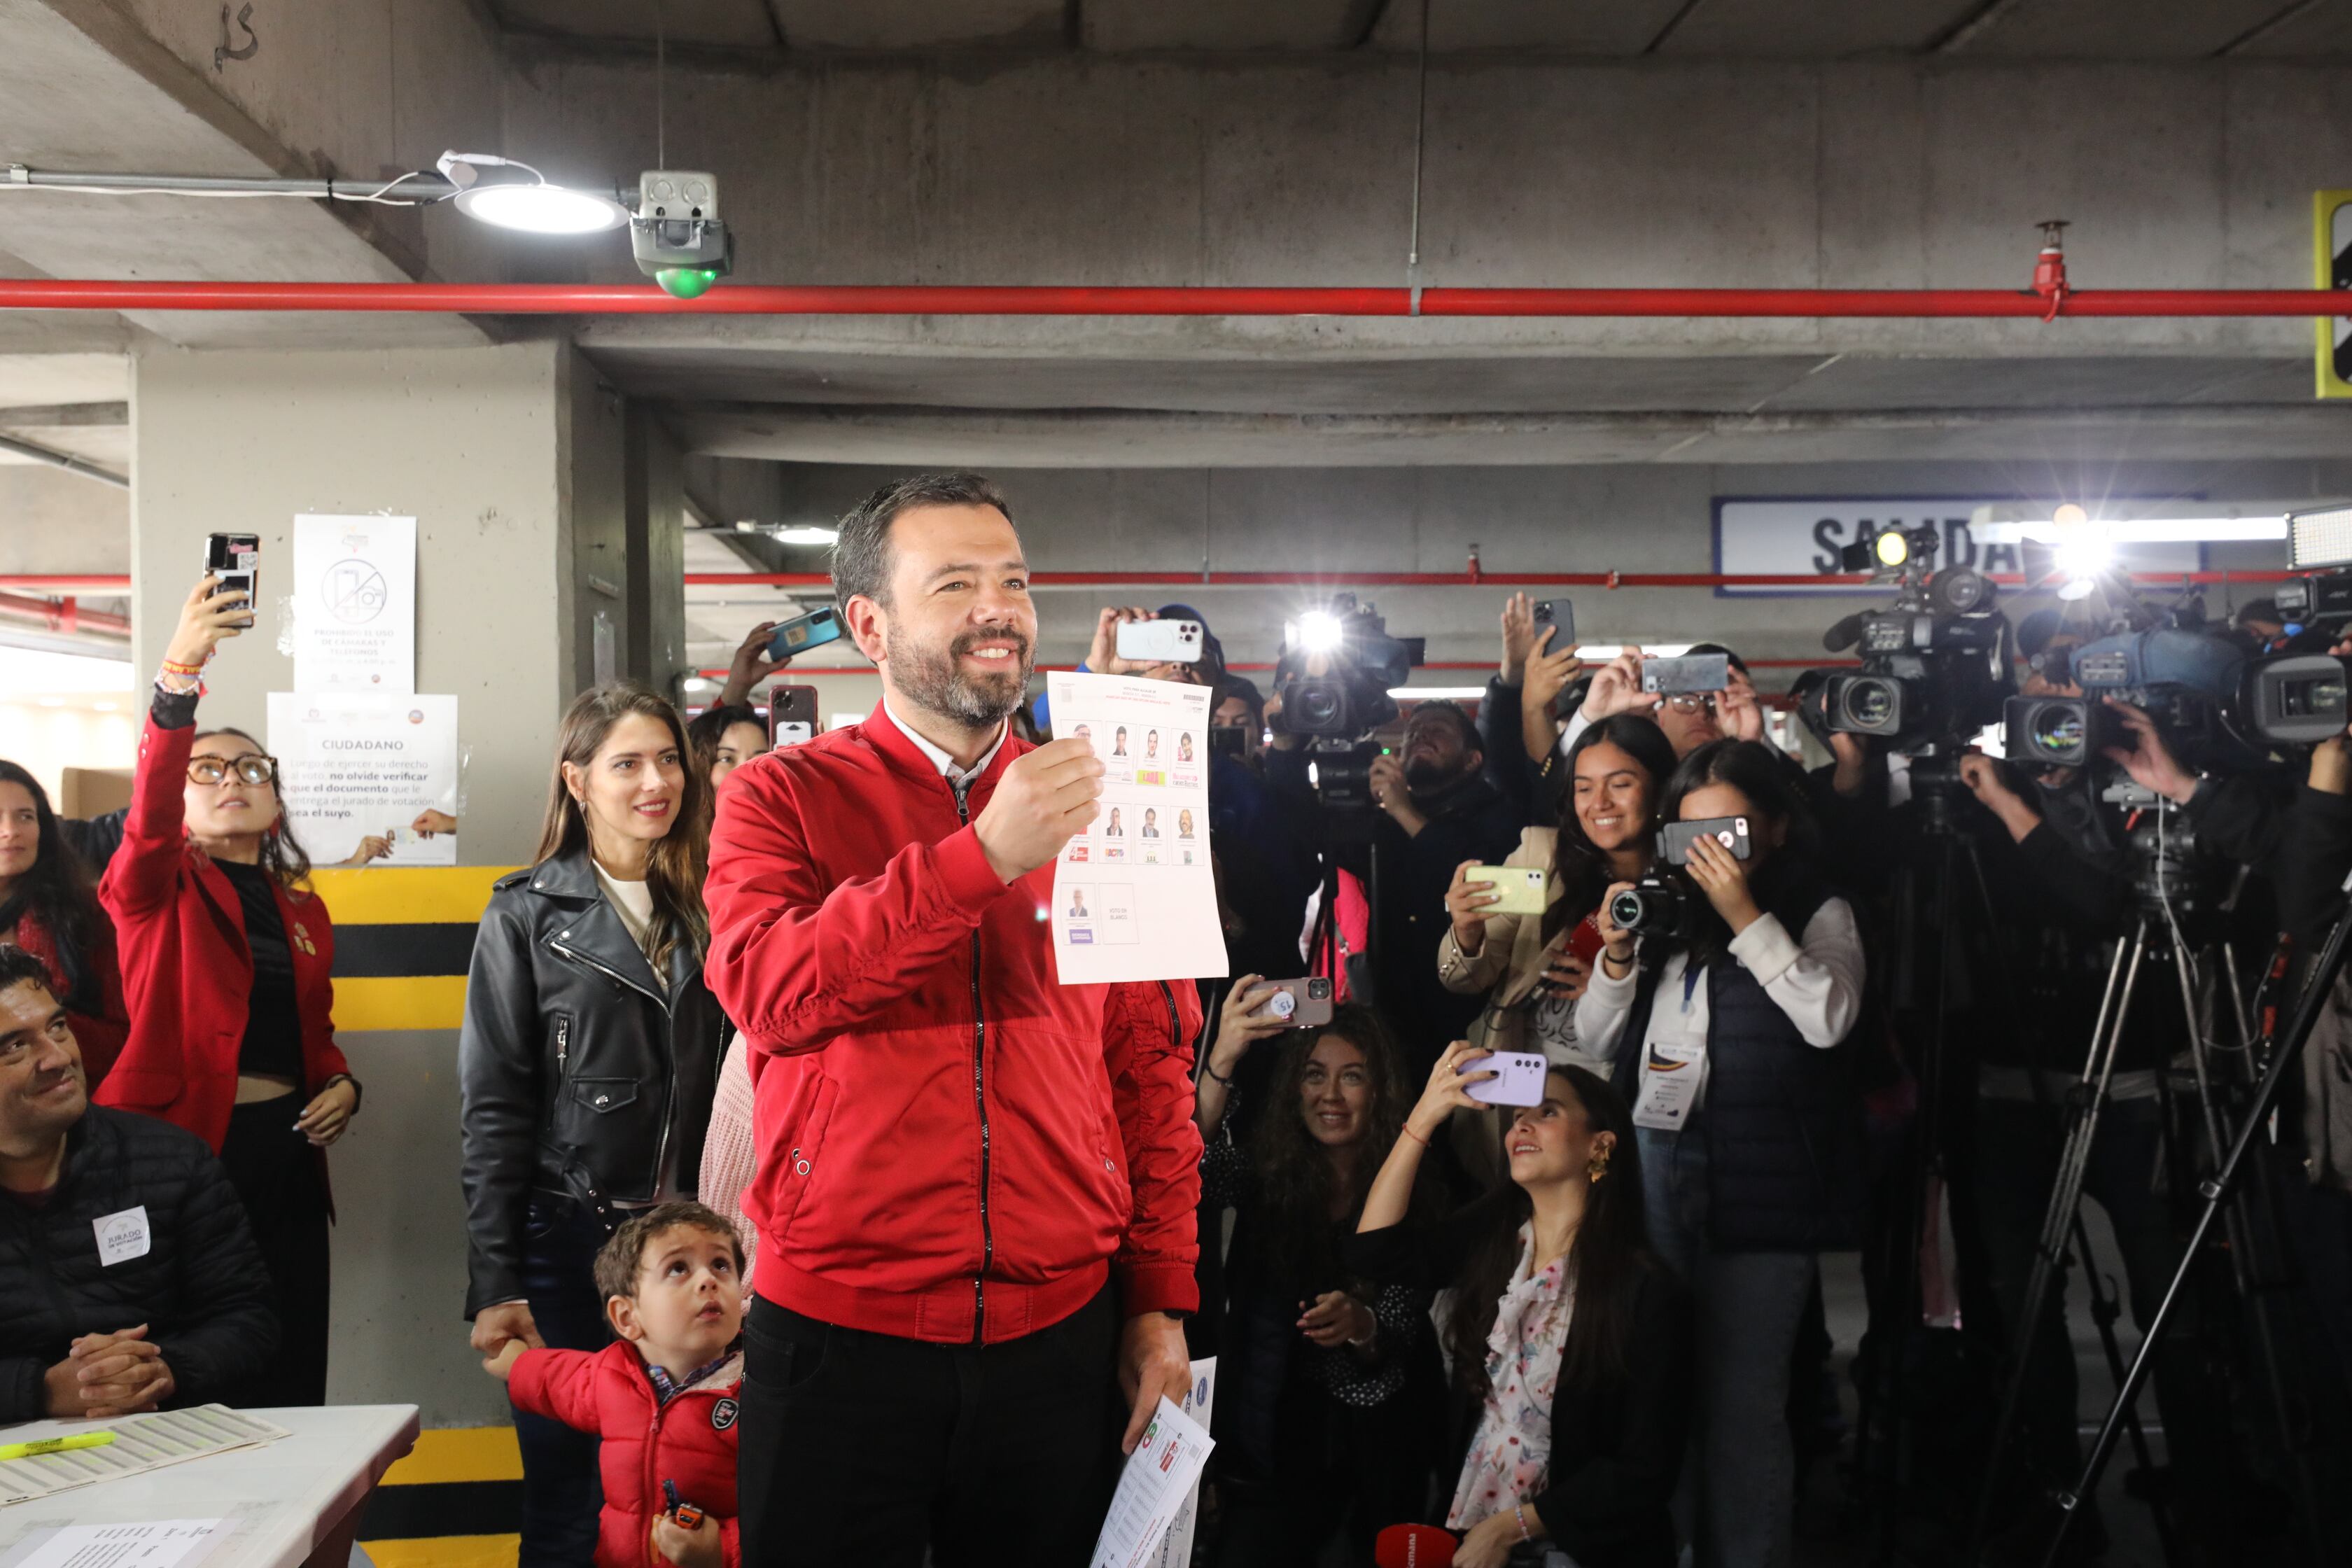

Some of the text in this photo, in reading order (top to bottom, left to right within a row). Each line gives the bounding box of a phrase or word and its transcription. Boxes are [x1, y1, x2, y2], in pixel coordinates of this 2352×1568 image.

[322, 739, 404, 751] CIUDADANO
[290, 759, 321, 770] Luego
[323, 759, 336, 768] de
[338, 760, 371, 769] ejercer
[388, 760, 428, 769] derecho
[346, 771, 379, 780] olvide
[383, 771, 428, 781] verificar
[290, 783, 421, 794] que el documento que le
[290, 796, 435, 807] entrega el jurado de votación
[312, 808, 321, 817] el
[324, 810, 354, 820] suyo.
[108, 1229, 141, 1244] JURADO
